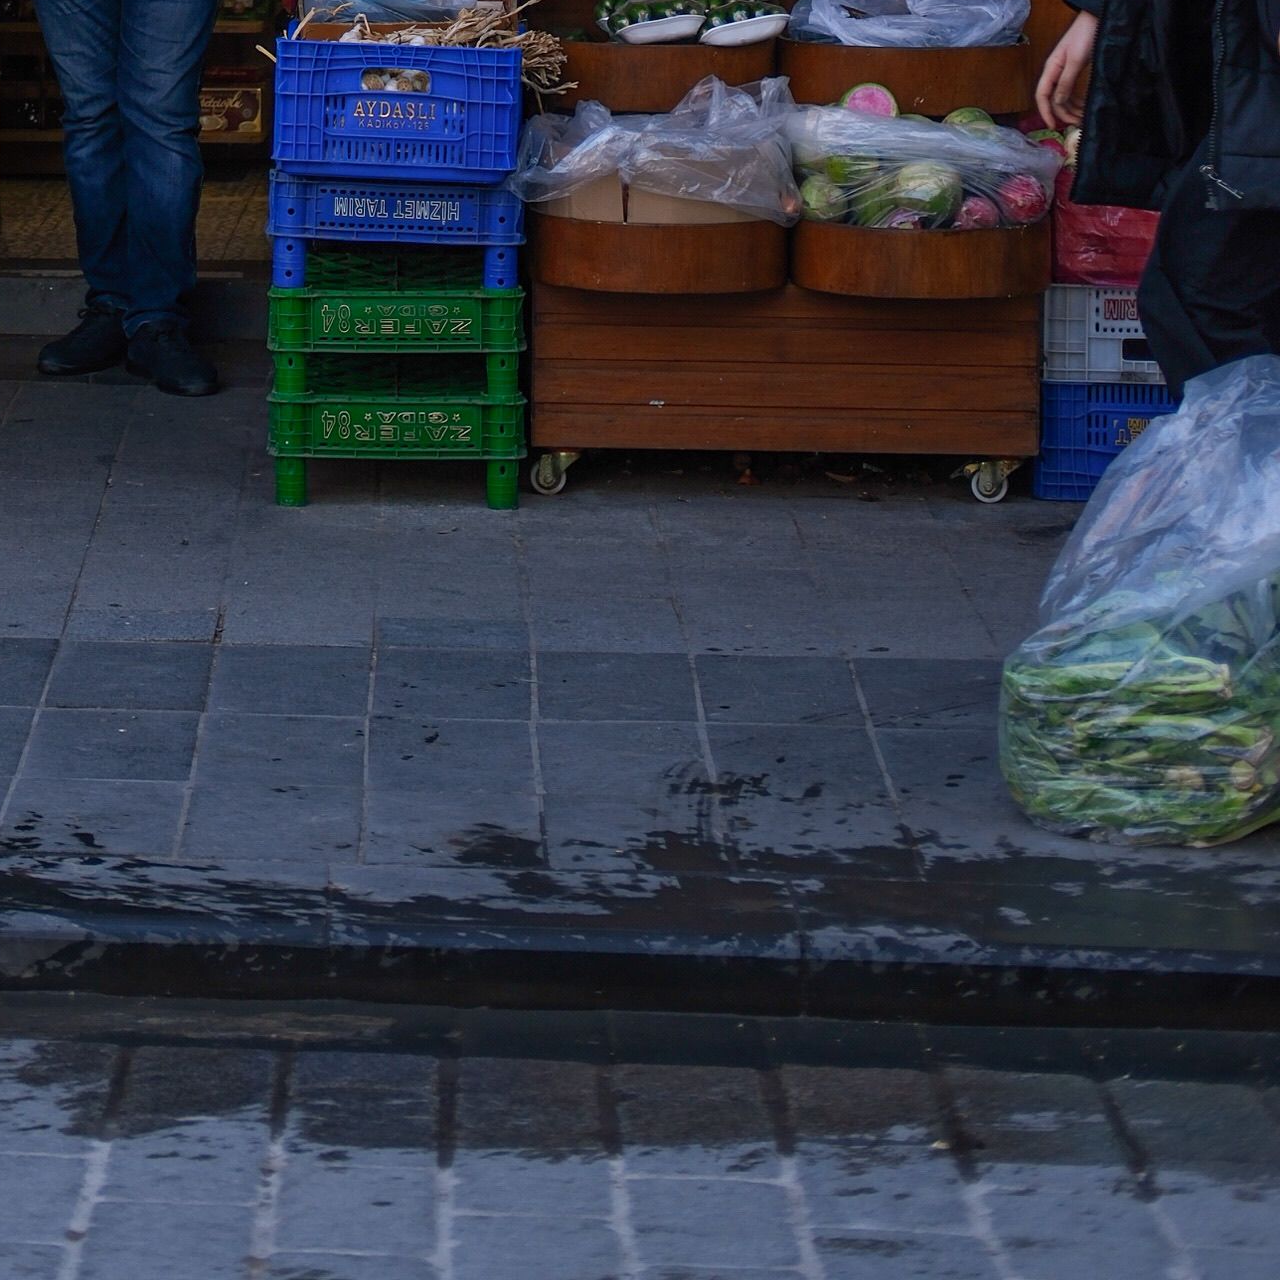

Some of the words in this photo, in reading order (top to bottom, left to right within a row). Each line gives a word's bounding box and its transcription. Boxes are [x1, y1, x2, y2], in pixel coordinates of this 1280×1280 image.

[353, 100, 436, 121] AYDAŞLI
[333, 196, 389, 220] TARIM
[393, 199, 461, 226] HİZMET
[321, 304, 351, 333] 84
[376, 304, 449, 317] GIDA
[353, 318, 473, 335] ZAFER
[321, 410, 351, 439] 84
[376, 411, 449, 424] GIDA
[353, 424, 473, 441] ZAFER
